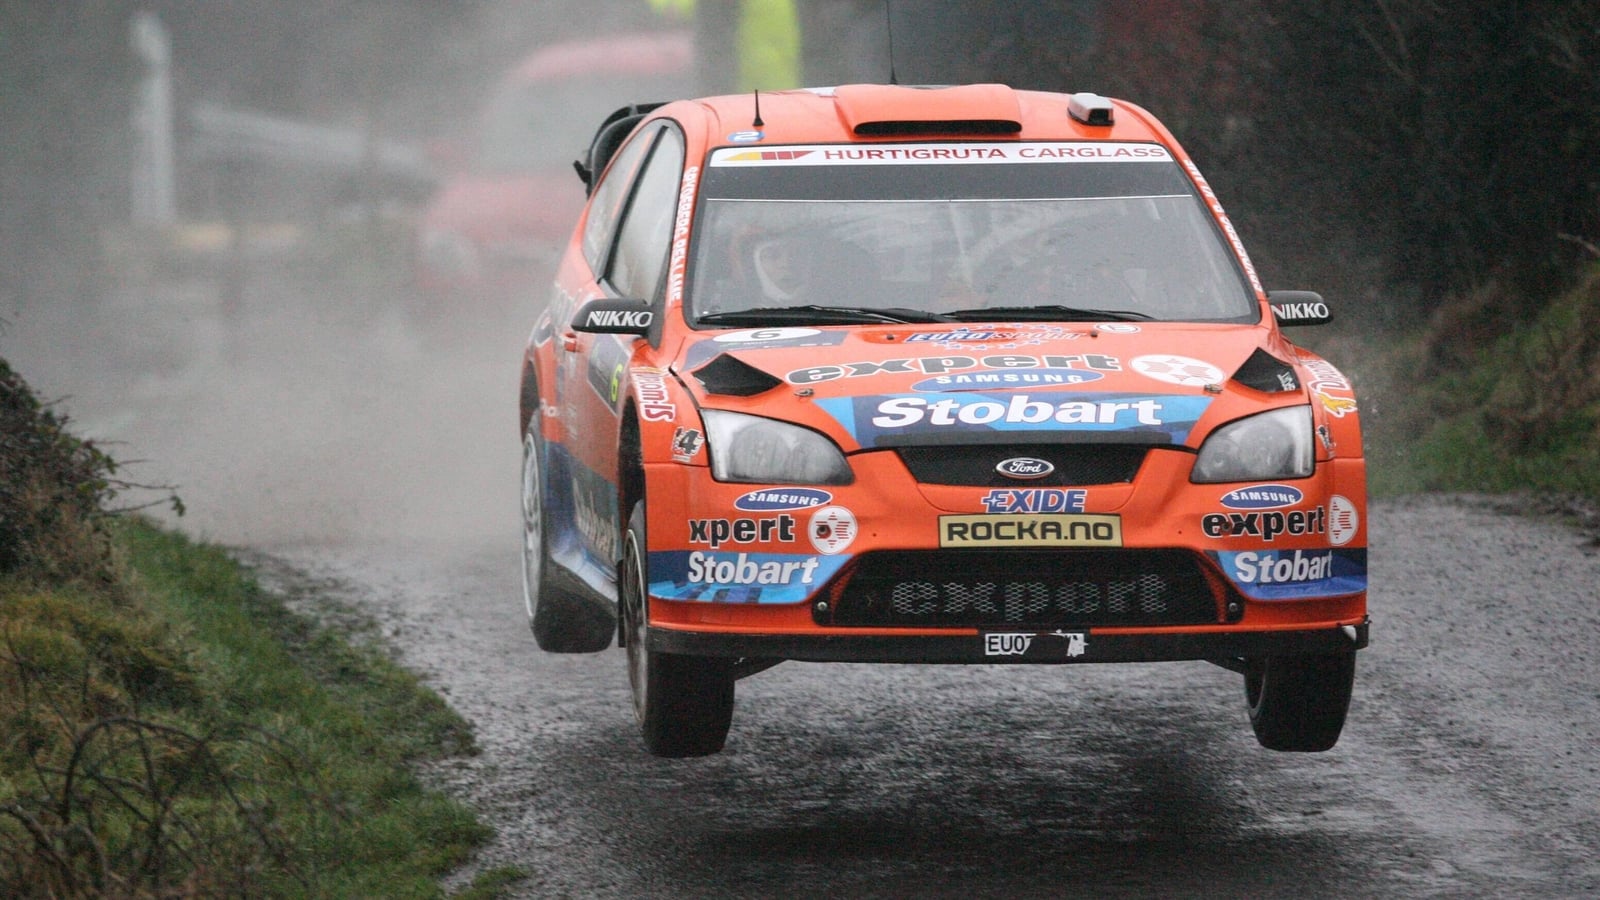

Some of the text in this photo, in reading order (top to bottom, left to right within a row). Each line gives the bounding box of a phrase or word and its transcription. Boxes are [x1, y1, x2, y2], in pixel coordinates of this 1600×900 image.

[824, 147, 1166, 160] HURTIGRUTA CARGLASS
[585, 310, 654, 327] NIKKO
[1270, 302, 1329, 319] NIKKO
[751, 329, 782, 340] 6
[785, 354, 1122, 385] expert
[936, 371, 1082, 385] SAMSUNG
[610, 363, 623, 402] 6
[872, 395, 1163, 428] Stobart
[1009, 460, 1042, 474] Ford
[748, 490, 820, 507] SAMSUNG
[981, 489, 1087, 513] EXIDE
[1230, 491, 1296, 504] SAMSUNG
[688, 514, 796, 548] xpert
[947, 520, 1114, 541] ROCKA.NO
[1202, 505, 1326, 541] expert
[688, 551, 819, 584] Stobart
[1234, 549, 1333, 583] Stobart
[891, 574, 1168, 622] expert
